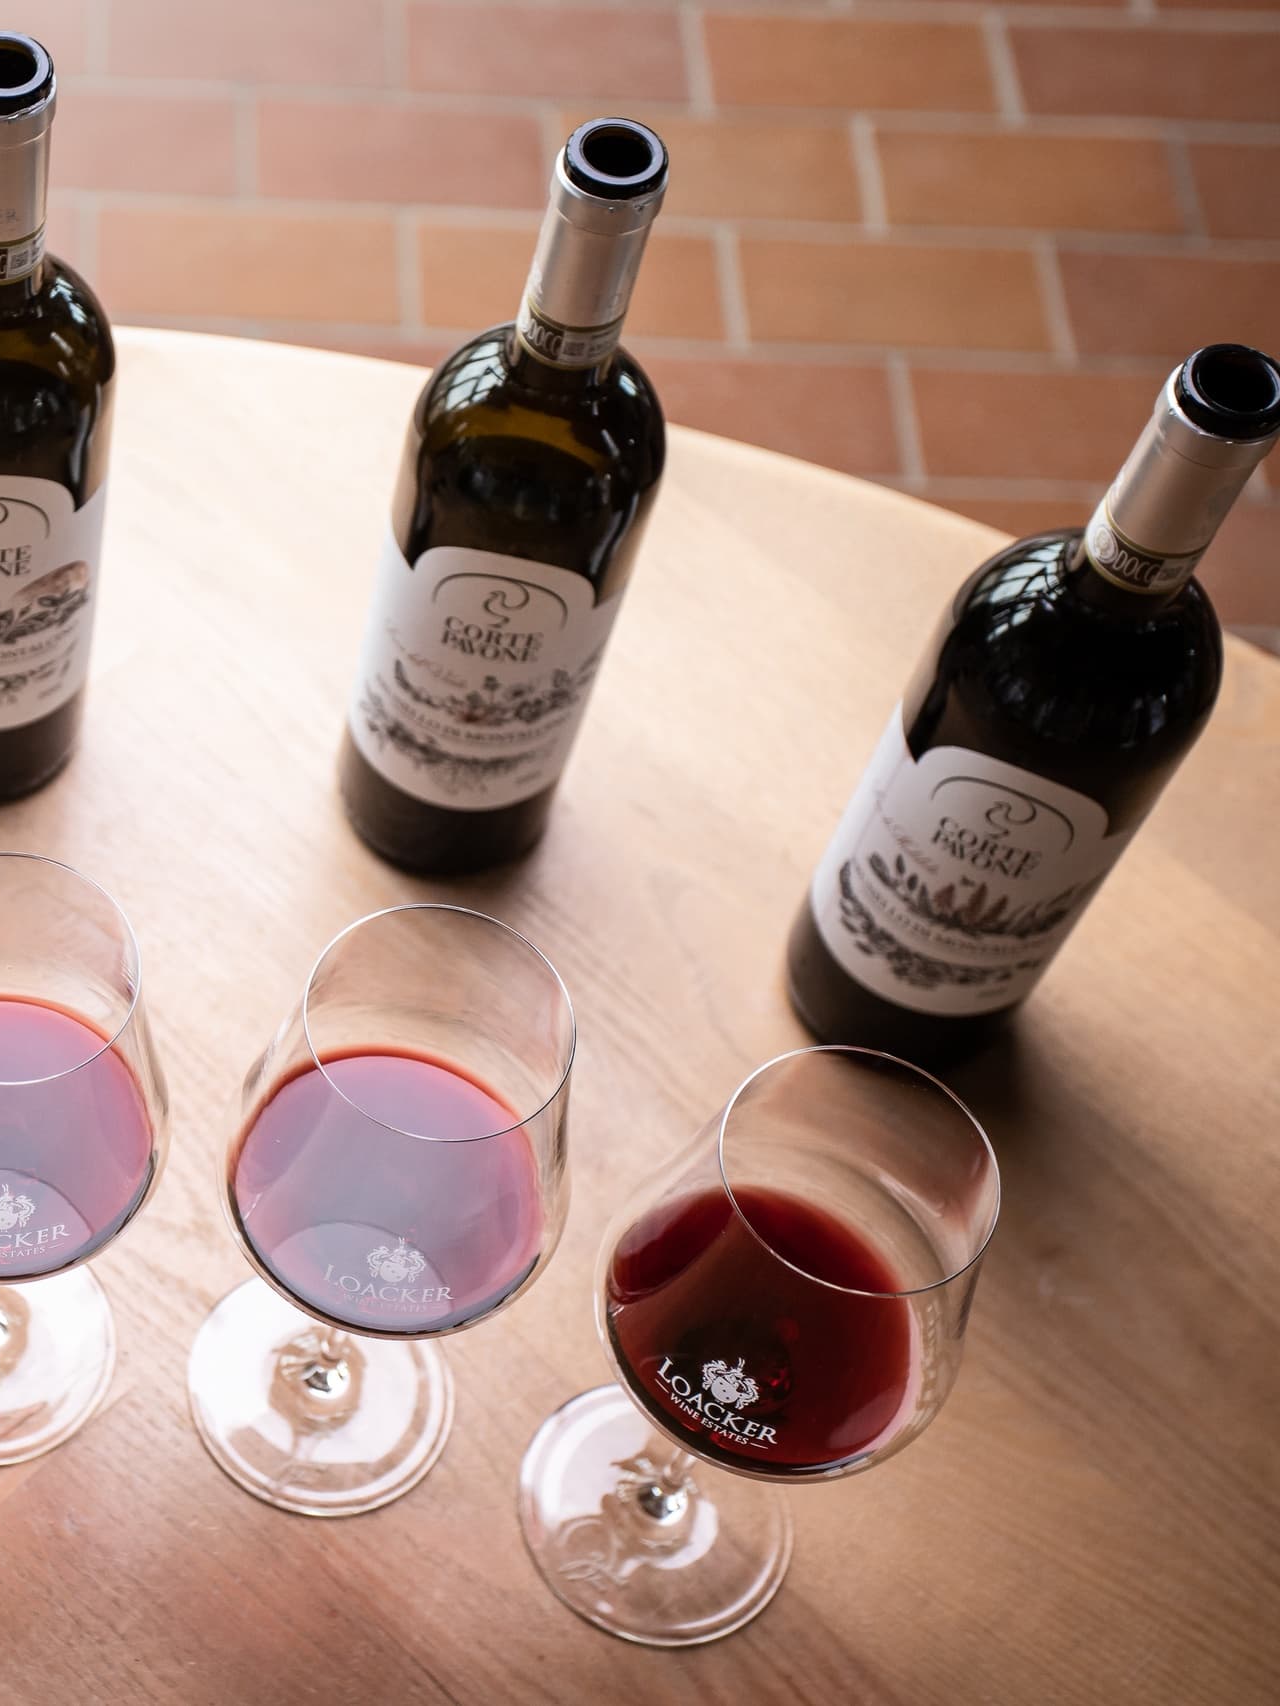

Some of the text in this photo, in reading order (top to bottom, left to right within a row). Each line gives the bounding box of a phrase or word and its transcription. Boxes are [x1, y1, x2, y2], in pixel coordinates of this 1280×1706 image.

[441, 629, 541, 663] PAVONE
[444, 616, 544, 650] CORTE
[938, 816, 1042, 869] CORTE
[323, 1263, 456, 1304] LOACKER
[656, 1356, 778, 1445] LOACKER
[669, 1392, 750, 1446] WINE ESTATES
